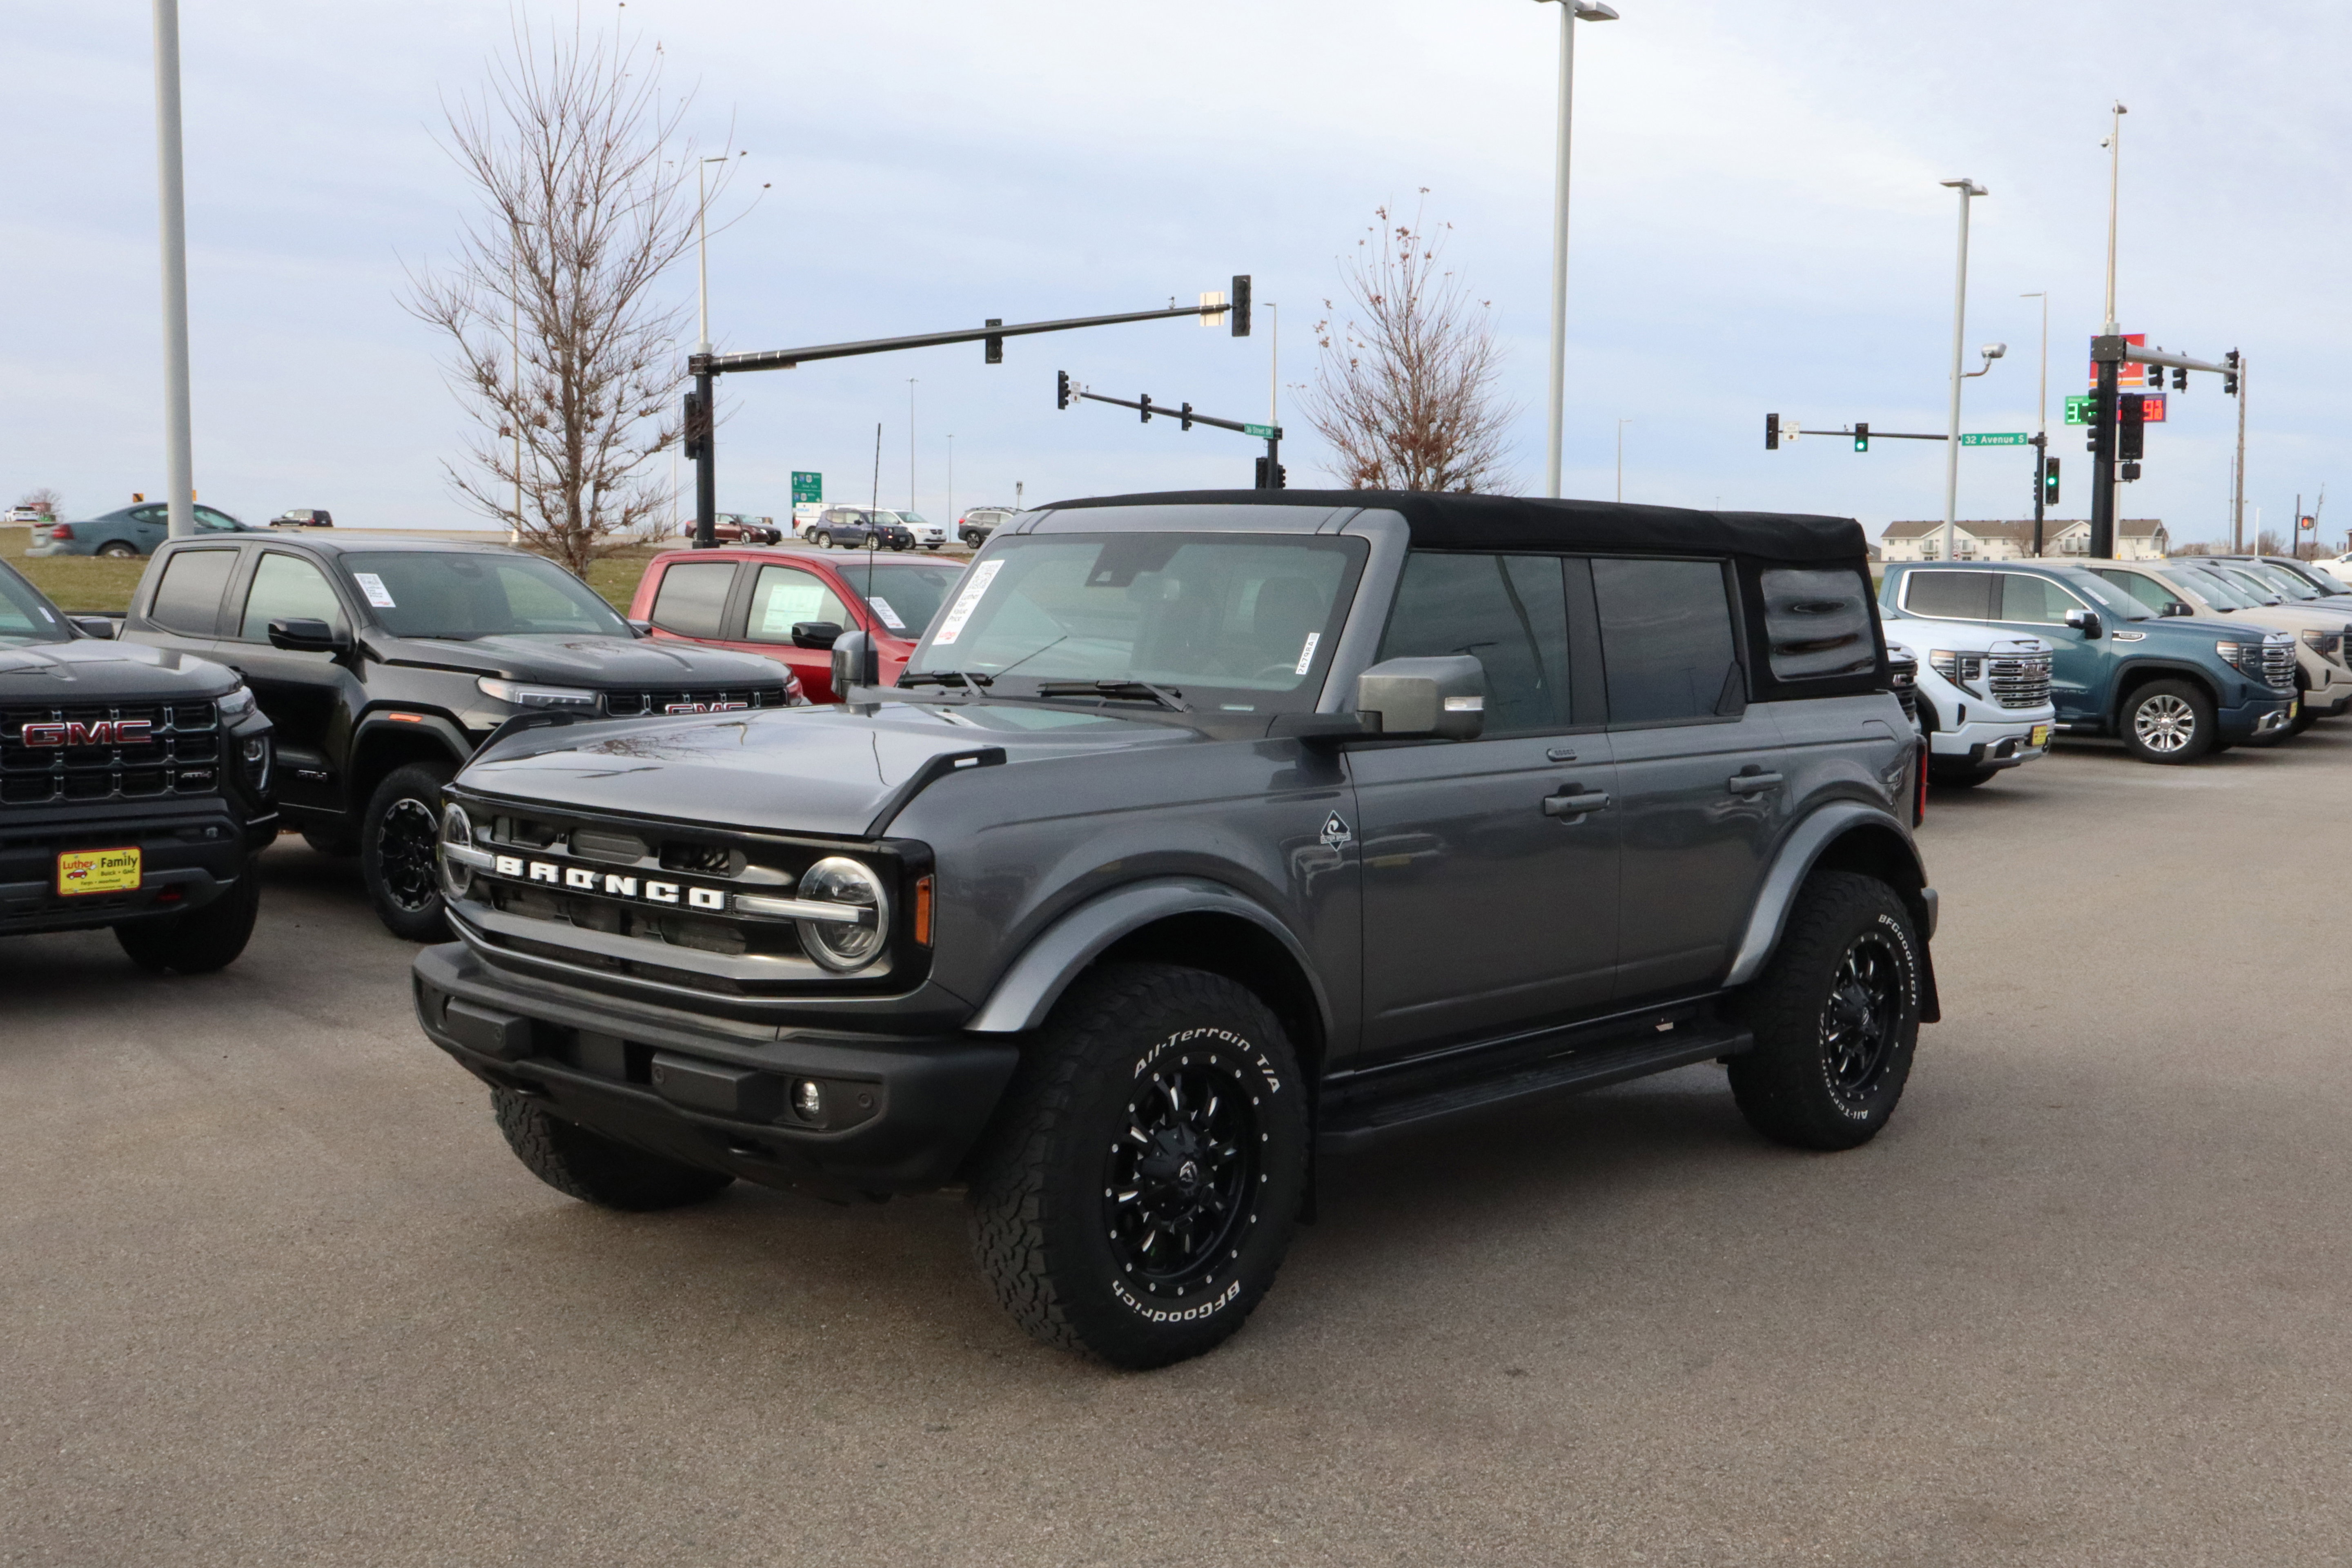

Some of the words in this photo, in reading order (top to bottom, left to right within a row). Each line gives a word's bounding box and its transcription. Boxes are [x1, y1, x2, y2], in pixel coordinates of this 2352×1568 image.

[1965, 436, 1977, 444] 32
[1981, 435, 2014, 444] Avenue
[2018, 434, 2025, 443] S
[22, 720, 151, 747] GMC
[63, 860, 94, 870] Luther
[101, 855, 138, 868] Family
[497, 855, 725, 910] BRONCO
[1878, 914, 1916, 1006] BFGoodrich
[1134, 1028, 1250, 1079] All-Terrain
[1257, 1053, 1281, 1094] T/A
[1112, 1280, 1240, 1322] BFGoodrich
